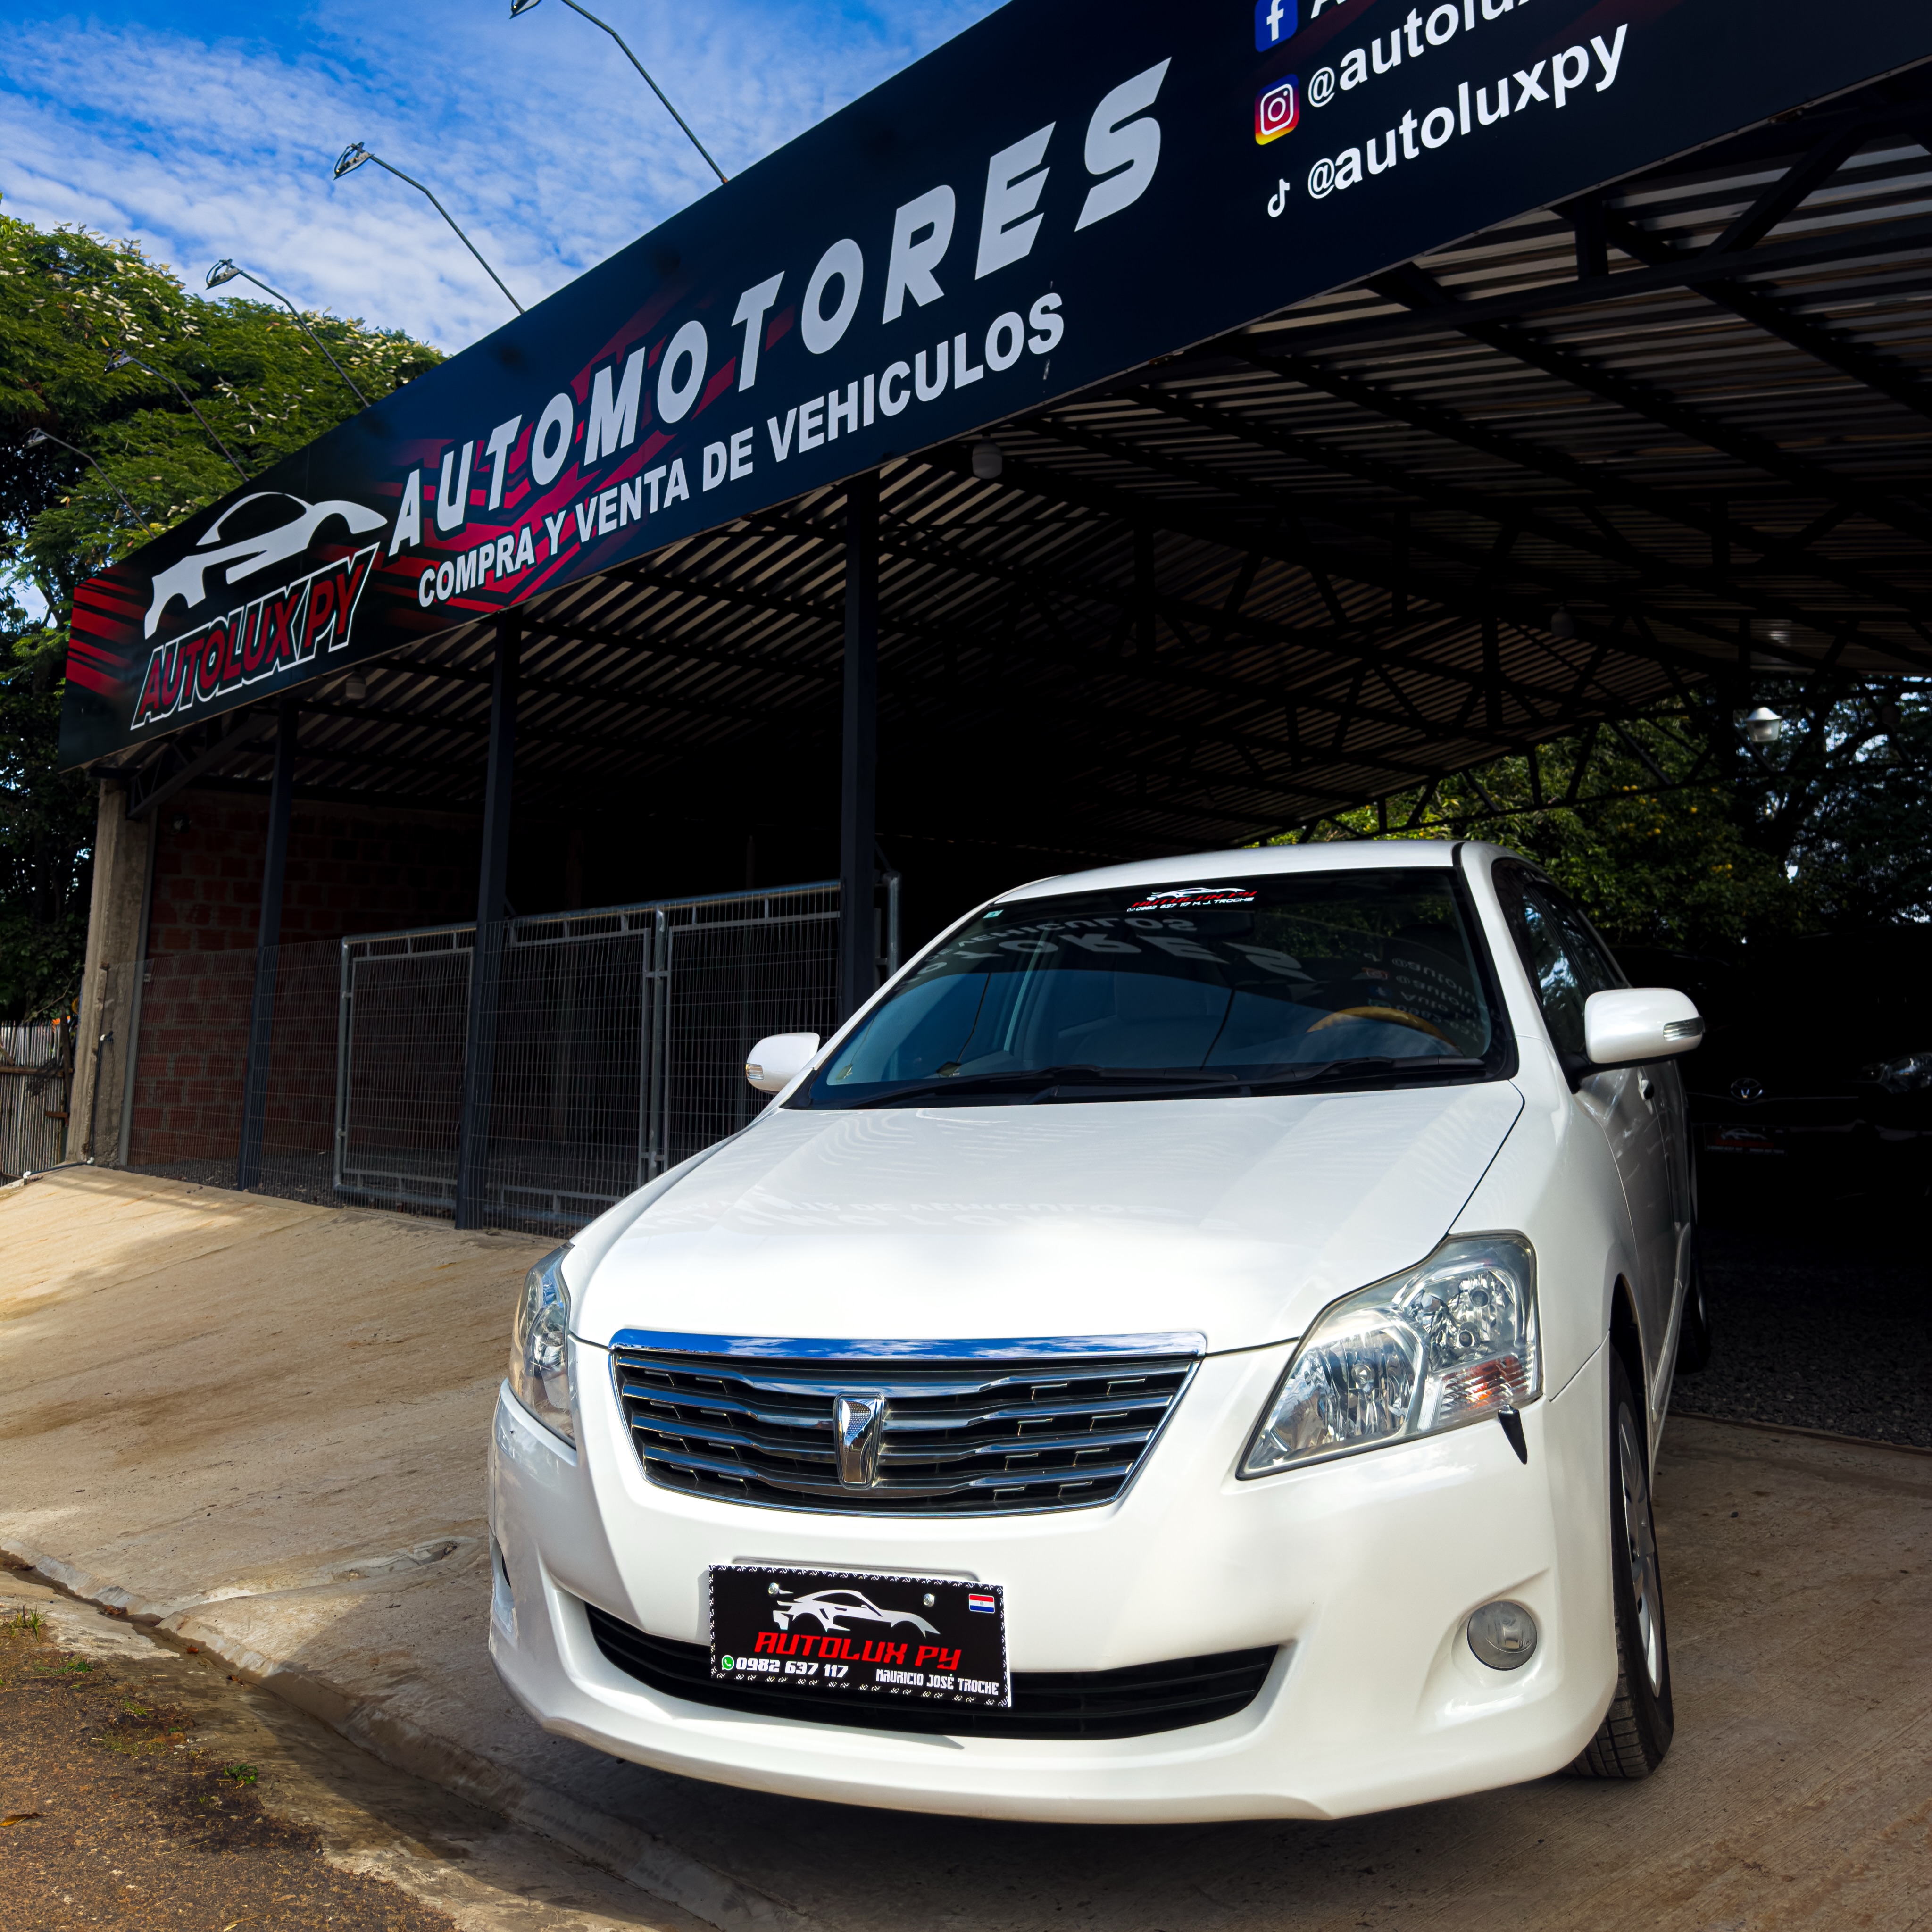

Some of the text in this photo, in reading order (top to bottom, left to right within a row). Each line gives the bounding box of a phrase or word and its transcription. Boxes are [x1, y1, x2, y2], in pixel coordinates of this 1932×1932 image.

[1308, 0, 1529, 108] @autolu
[1307, 23, 1628, 199] @autoluxpy
[388, 57, 1172, 557] AUTOMOTORES
[418, 292, 1064, 608] COMPRA Y VENTA DE VEHICULOS
[735, 1657, 849, 1678] 0982 637 117
[754, 1632, 961, 1670] AUTOLUX PY
[875, 1669, 924, 1686] MAURICIO
[926, 1673, 954, 1690] JOSÉ
[957, 1678, 999, 1696] TROCHE
